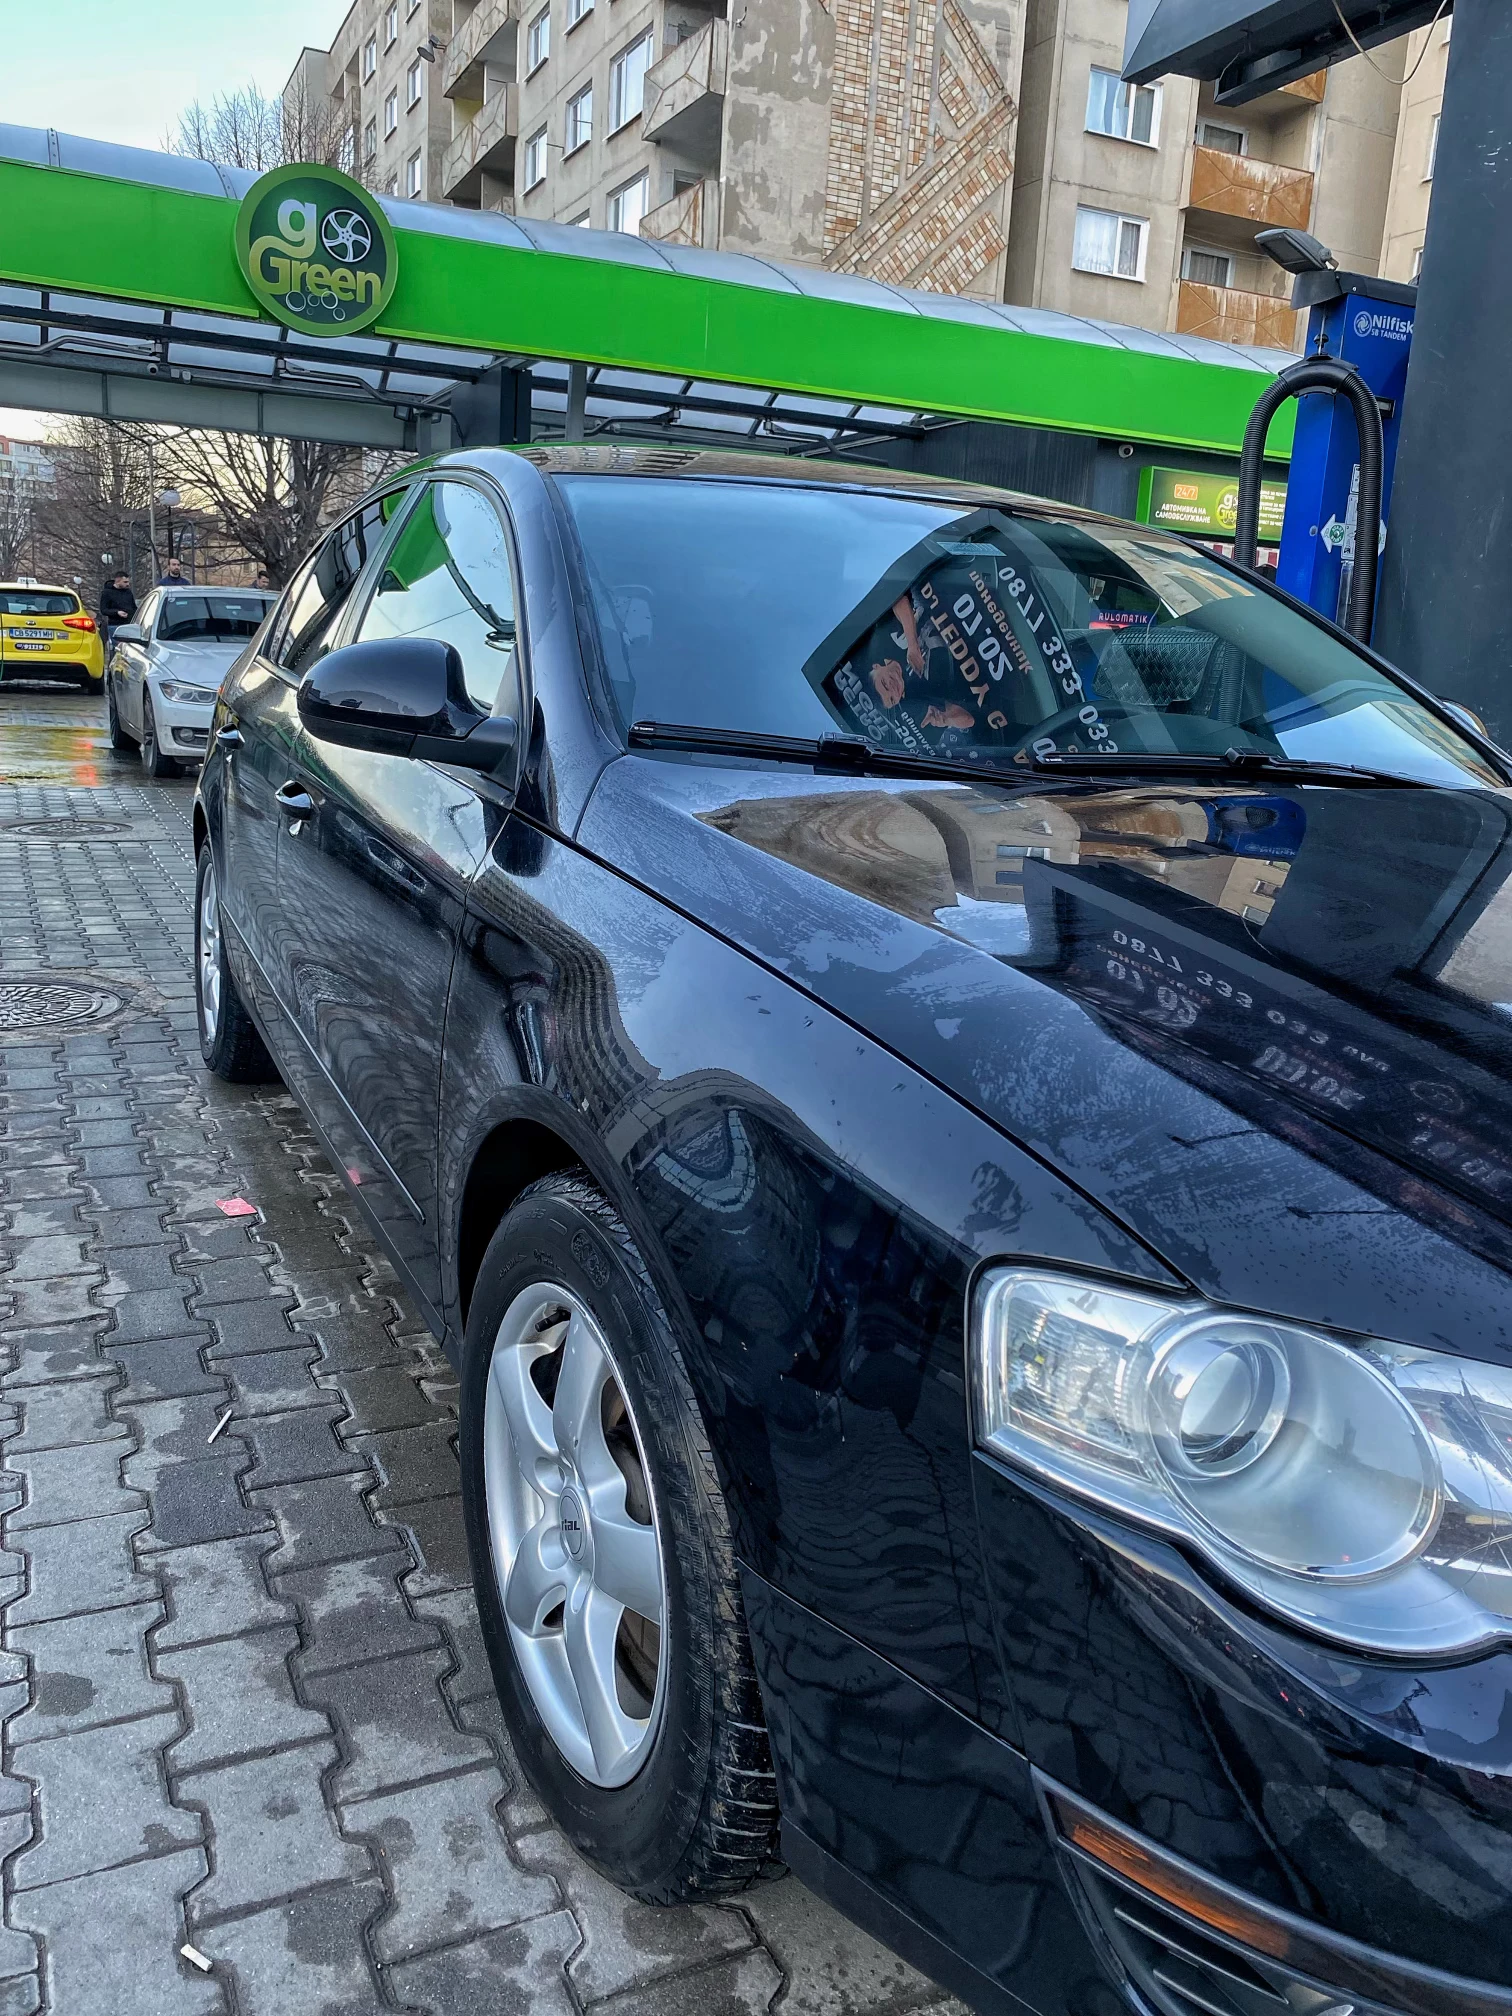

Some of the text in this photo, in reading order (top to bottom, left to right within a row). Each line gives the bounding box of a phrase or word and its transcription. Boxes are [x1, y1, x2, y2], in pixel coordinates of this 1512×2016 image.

[249, 236, 382, 305] Green
[1372, 314, 1414, 334] Nilfisk
[1380, 329, 1407, 342] TANDEM
[1176, 487, 1196, 498] 24/7
[1161, 503, 1207, 515] АВТОМИВКА НА
[1155, 510, 1211, 524] САМООБСЛУЖВАНЕ
